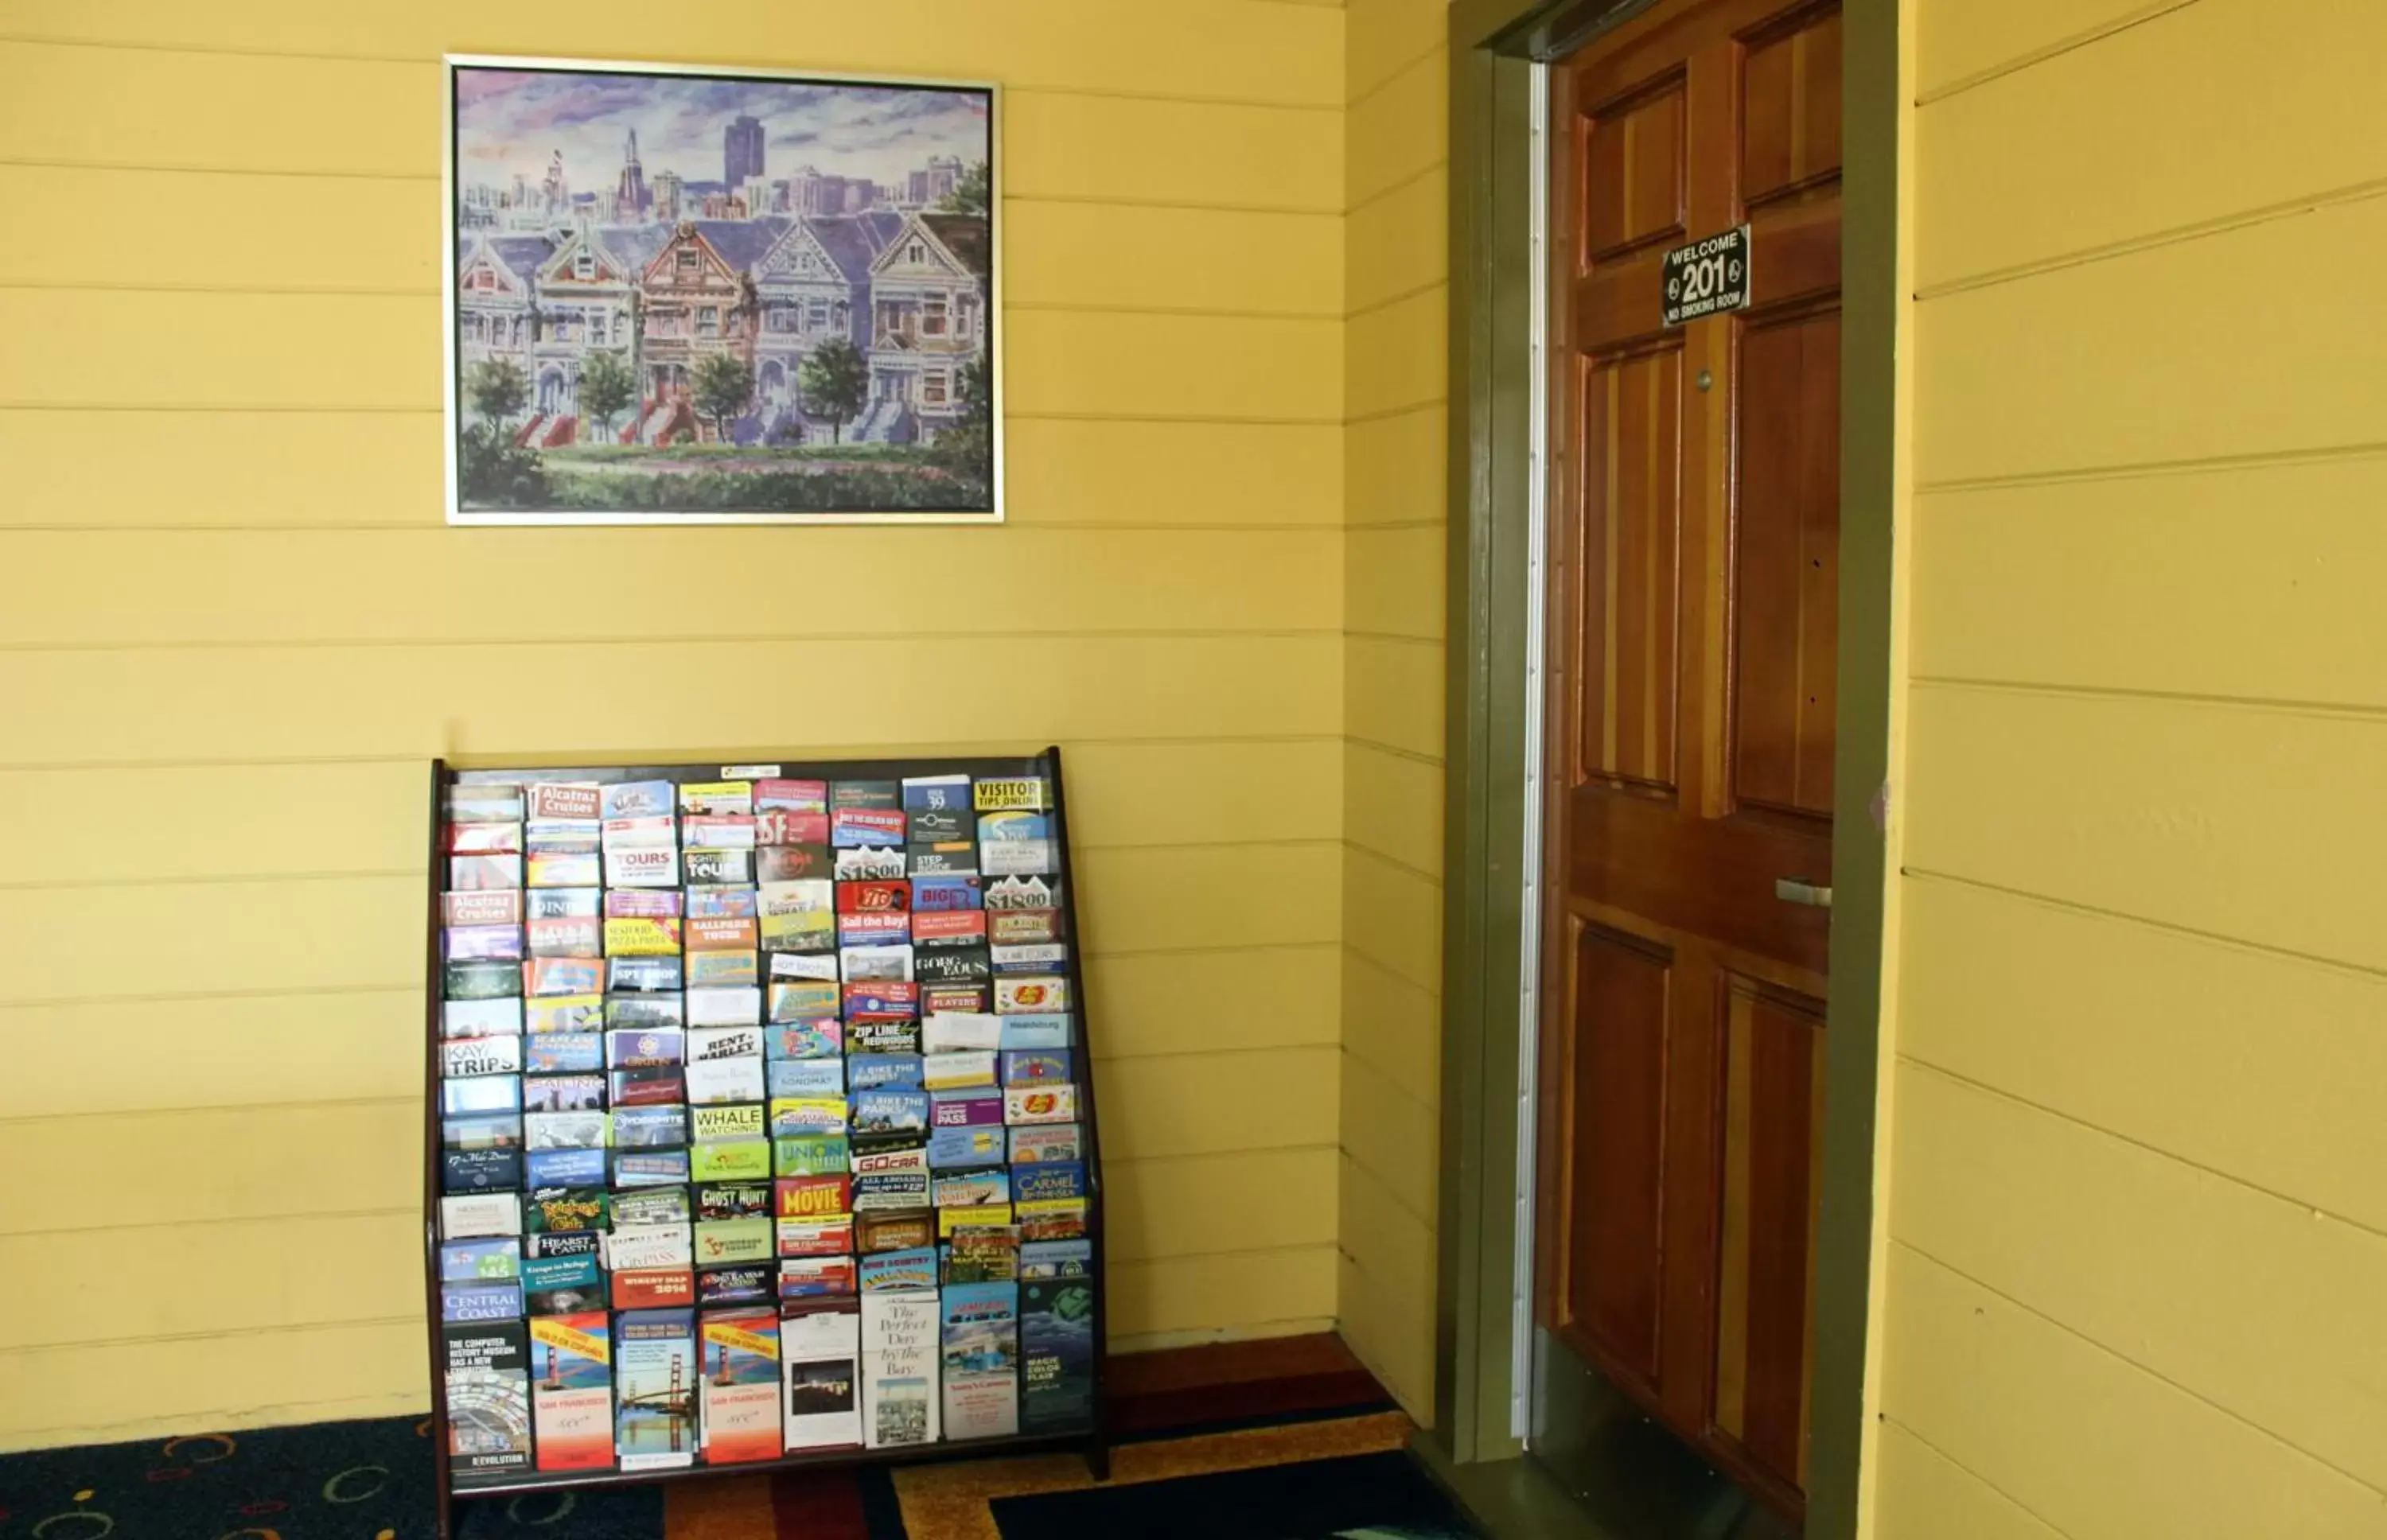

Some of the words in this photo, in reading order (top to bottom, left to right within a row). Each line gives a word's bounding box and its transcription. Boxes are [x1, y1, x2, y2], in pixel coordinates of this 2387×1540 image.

[1672, 232, 1738, 266] WELCOME
[1683, 254, 1724, 303] 201
[1668, 307, 1679, 321] NO
[1681, 298, 1715, 318] SMOKING
[1716, 291, 1741, 309] ROOM
[542, 786, 598, 802] Alcatraz
[979, 782, 1039, 795] VISITOR
[544, 801, 594, 813] Cruises
[615, 852, 671, 865] TOURS
[454, 896, 509, 907] Alcatraz
[455, 906, 507, 920] Cruises
[450, 1058, 513, 1073] TRIPS
[697, 1110, 761, 1125] WHALE
[700, 1125, 757, 1135] WATCHING
[782, 1142, 843, 1161] UNION
[701, 1190, 735, 1206] GHOST
[739, 1189, 768, 1205] HUNT
[784, 1190, 841, 1214] MOVIE
[542, 1237, 592, 1249] HEARST
[550, 1244, 598, 1255] CASTLE
[446, 1294, 516, 1307] CENTRAL
[457, 1308, 507, 1319] COAST
[879, 1319, 926, 1333] Perfect
[465, 1337, 505, 1347] COMPUTER
[483, 1347, 516, 1355] MUSEUM
[450, 1357, 464, 1367] HAS
[465, 1357, 472, 1366] A
